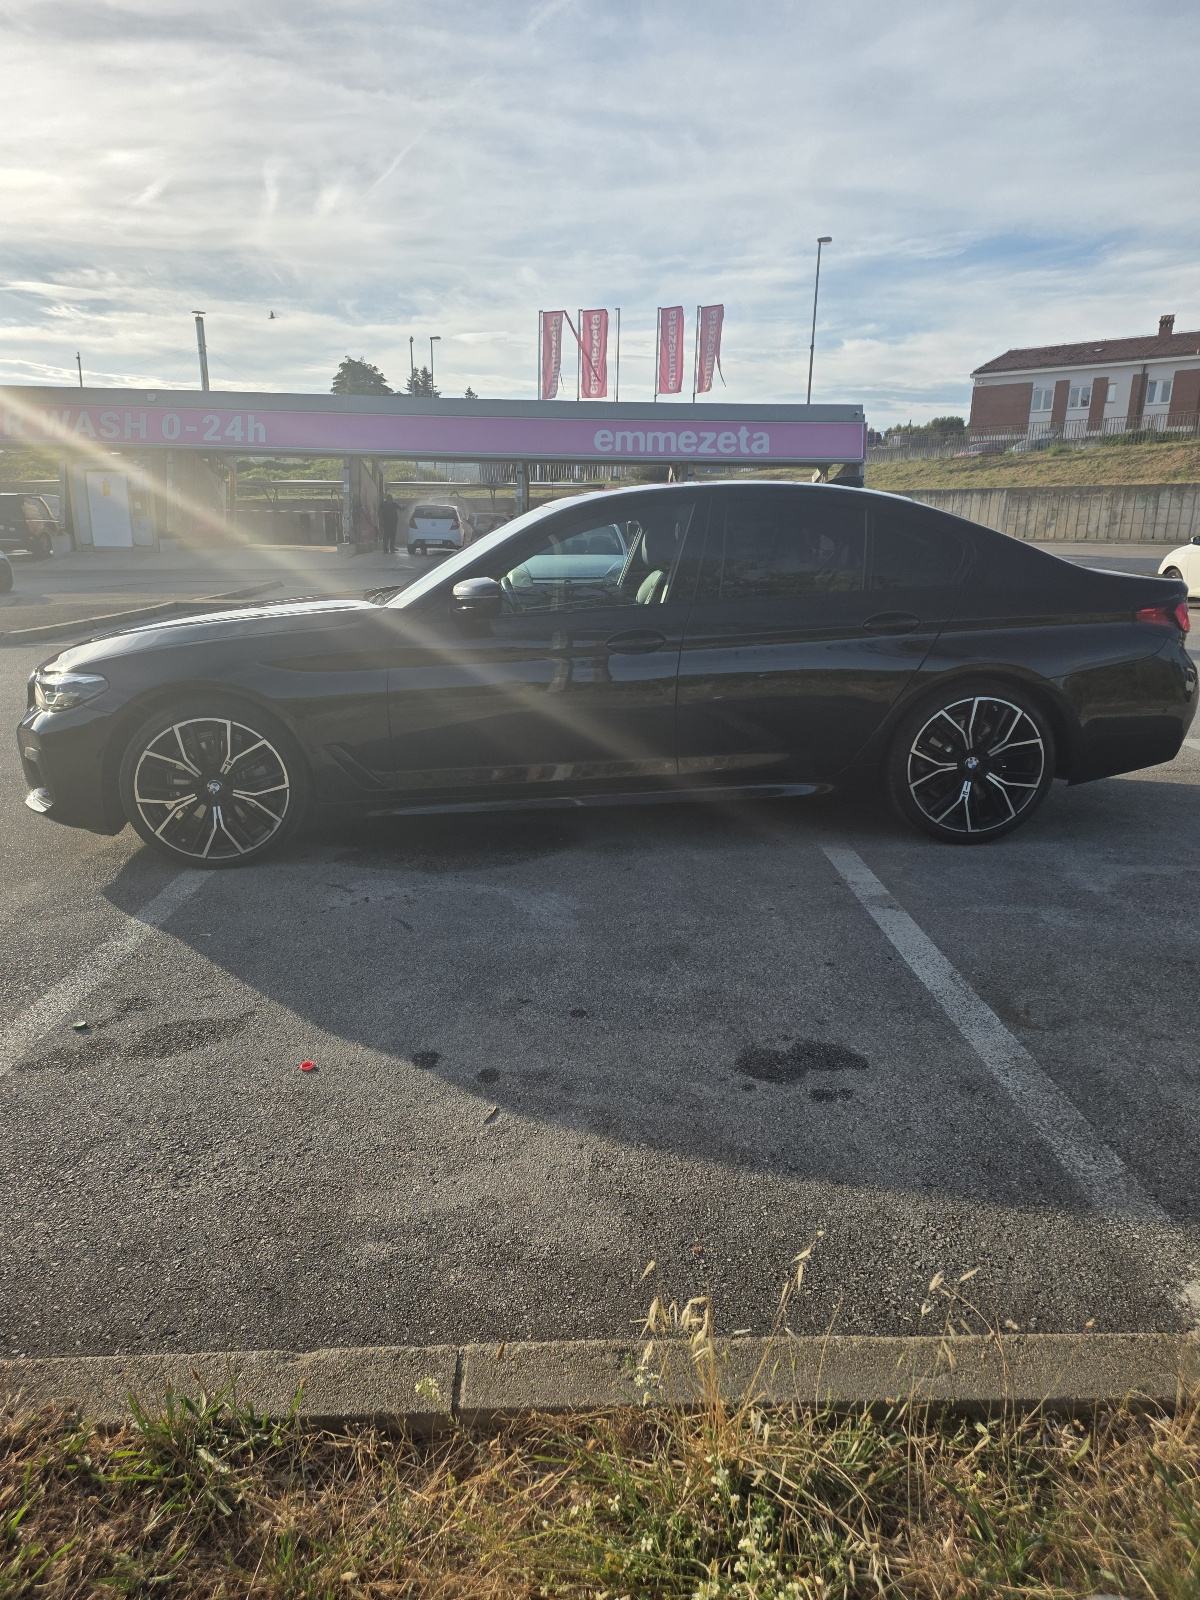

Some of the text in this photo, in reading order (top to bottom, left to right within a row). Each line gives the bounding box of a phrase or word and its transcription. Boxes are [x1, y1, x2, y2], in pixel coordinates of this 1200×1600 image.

[667, 310, 677, 390] emmezeta
[40, 410, 147, 439] WASH
[161, 413, 267, 443] 0-24h
[593, 426, 770, 454] emmezeta
